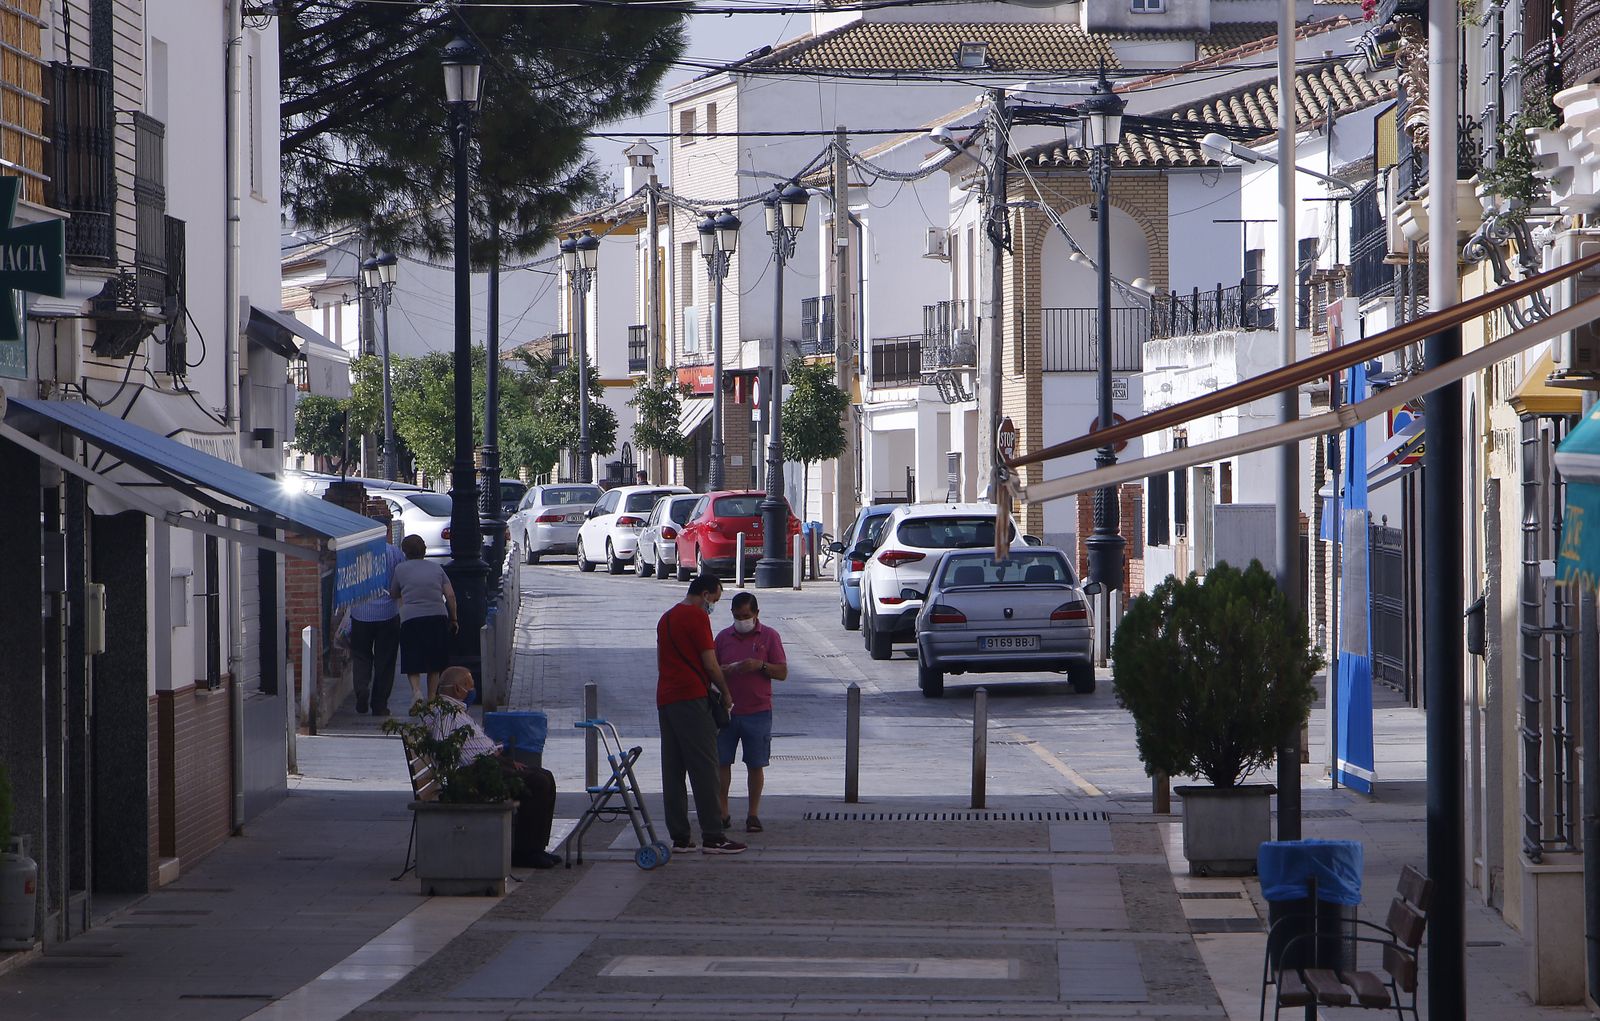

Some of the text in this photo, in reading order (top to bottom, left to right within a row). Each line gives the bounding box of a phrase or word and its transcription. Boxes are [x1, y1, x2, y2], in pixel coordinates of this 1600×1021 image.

[1000, 431, 1015, 447] STOP
[987, 637, 1035, 648] 9169 BBJ
